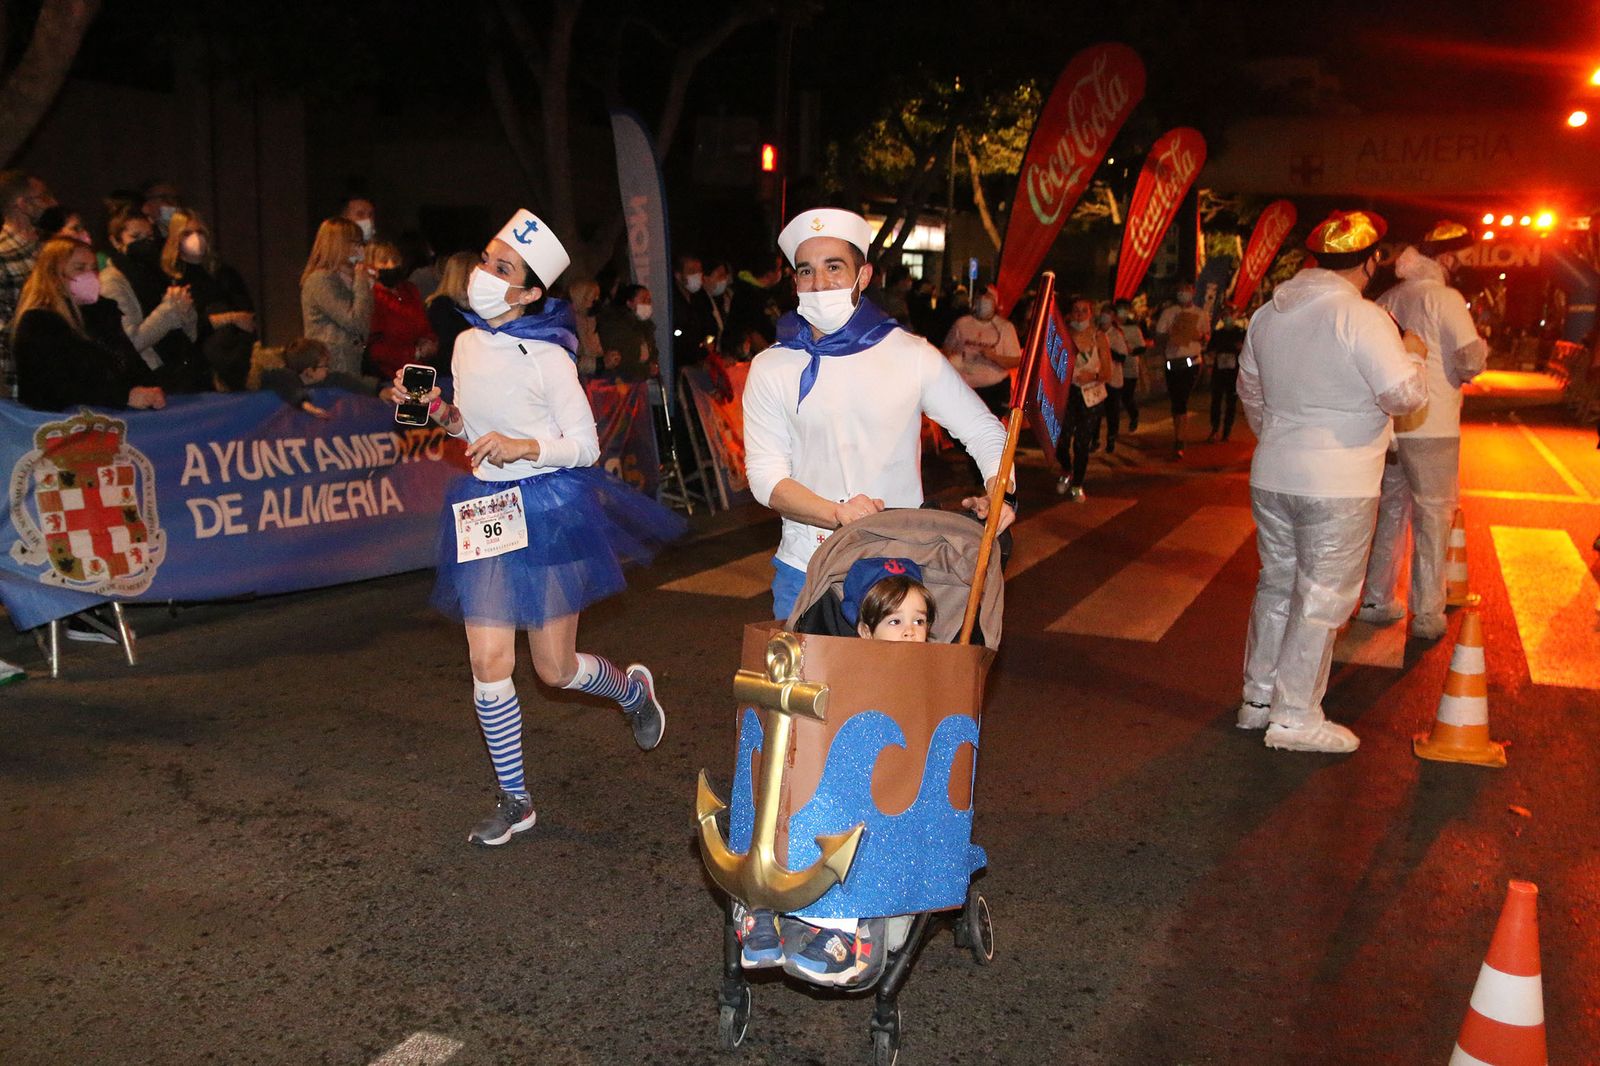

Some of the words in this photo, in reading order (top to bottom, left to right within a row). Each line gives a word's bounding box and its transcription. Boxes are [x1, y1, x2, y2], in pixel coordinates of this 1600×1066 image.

[180, 427, 446, 486] AYUNTAMIENTO
[185, 493, 248, 539] DE
[258, 470, 405, 531] ALMERÍA
[483, 521, 502, 538] 96
